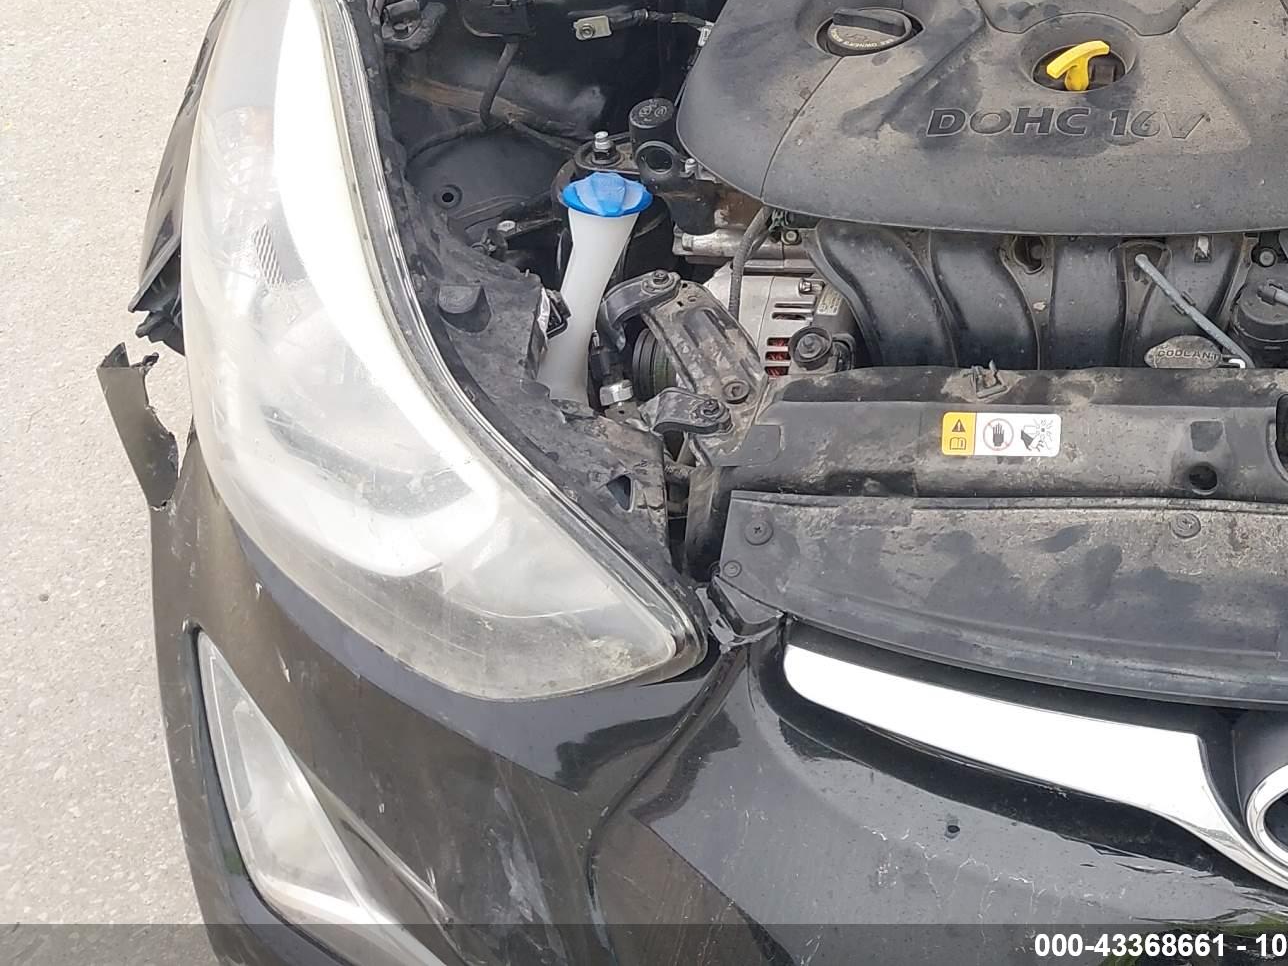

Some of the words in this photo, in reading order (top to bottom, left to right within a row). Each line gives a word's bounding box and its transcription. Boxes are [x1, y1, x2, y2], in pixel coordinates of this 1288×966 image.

[926, 107, 1091, 137] DOHC
[1109, 109, 1206, 139] 16V
[1157, 349, 1218, 361] COOLANT
